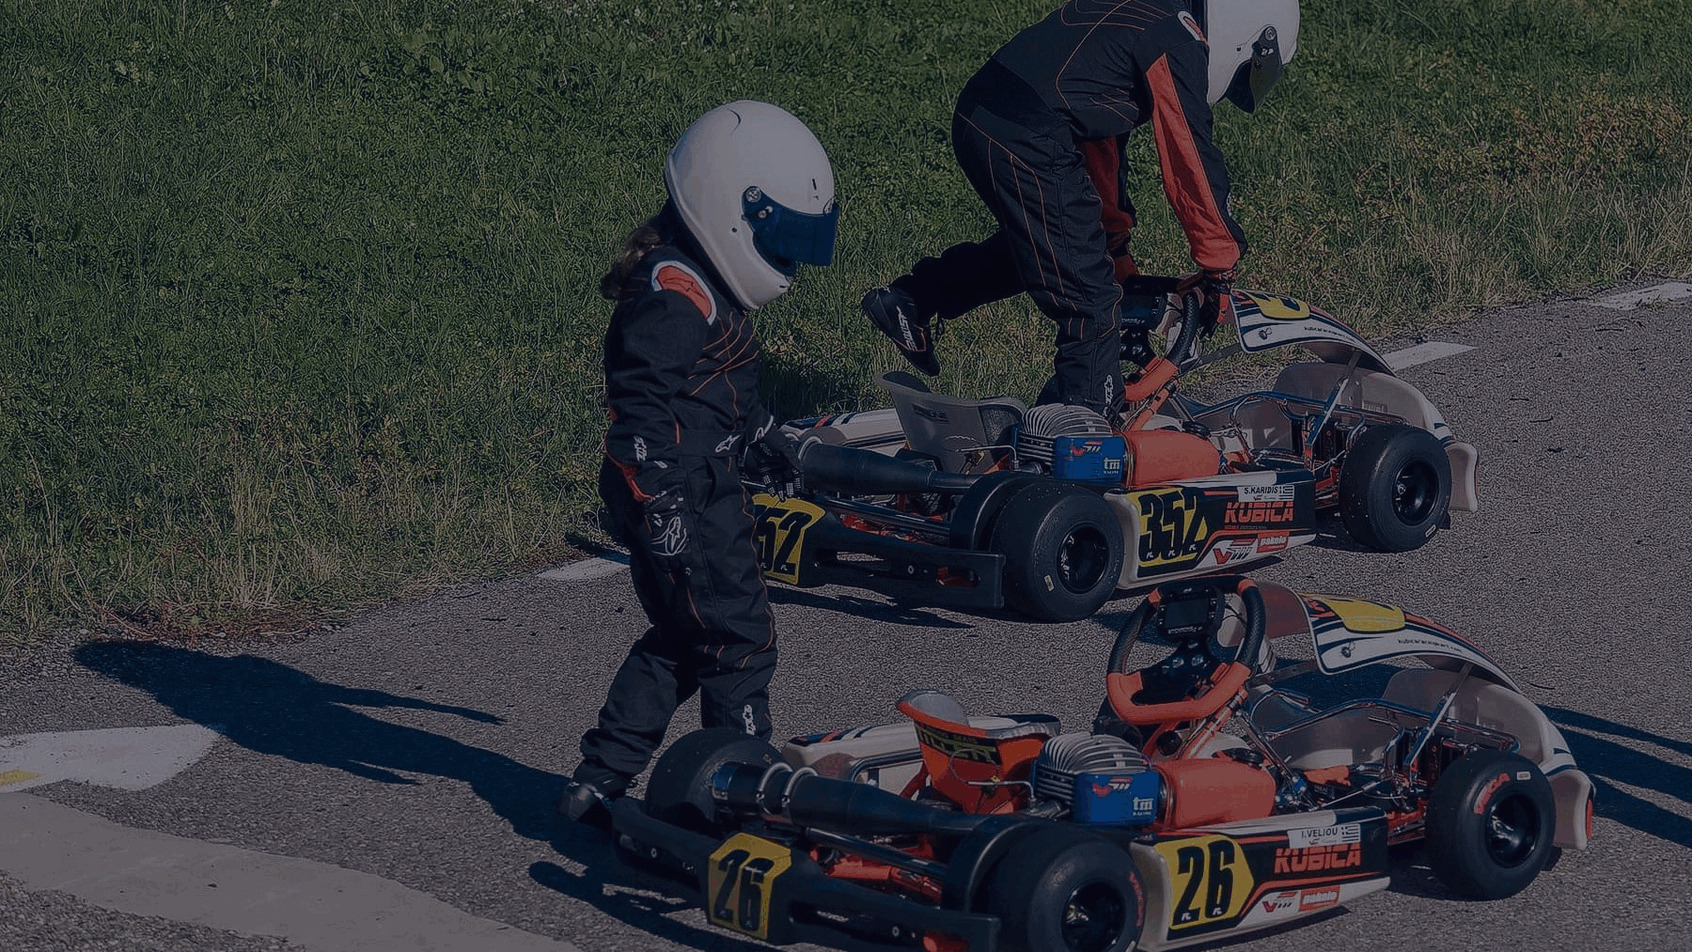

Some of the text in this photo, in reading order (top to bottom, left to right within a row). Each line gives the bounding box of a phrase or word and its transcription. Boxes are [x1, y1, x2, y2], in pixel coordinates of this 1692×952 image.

[1138, 486, 1206, 563] 352
[1224, 501, 1294, 524] KUBICA
[714, 848, 775, 931] 26
[1172, 840, 1235, 926] 26
[1274, 843, 1361, 874] KUBICA
